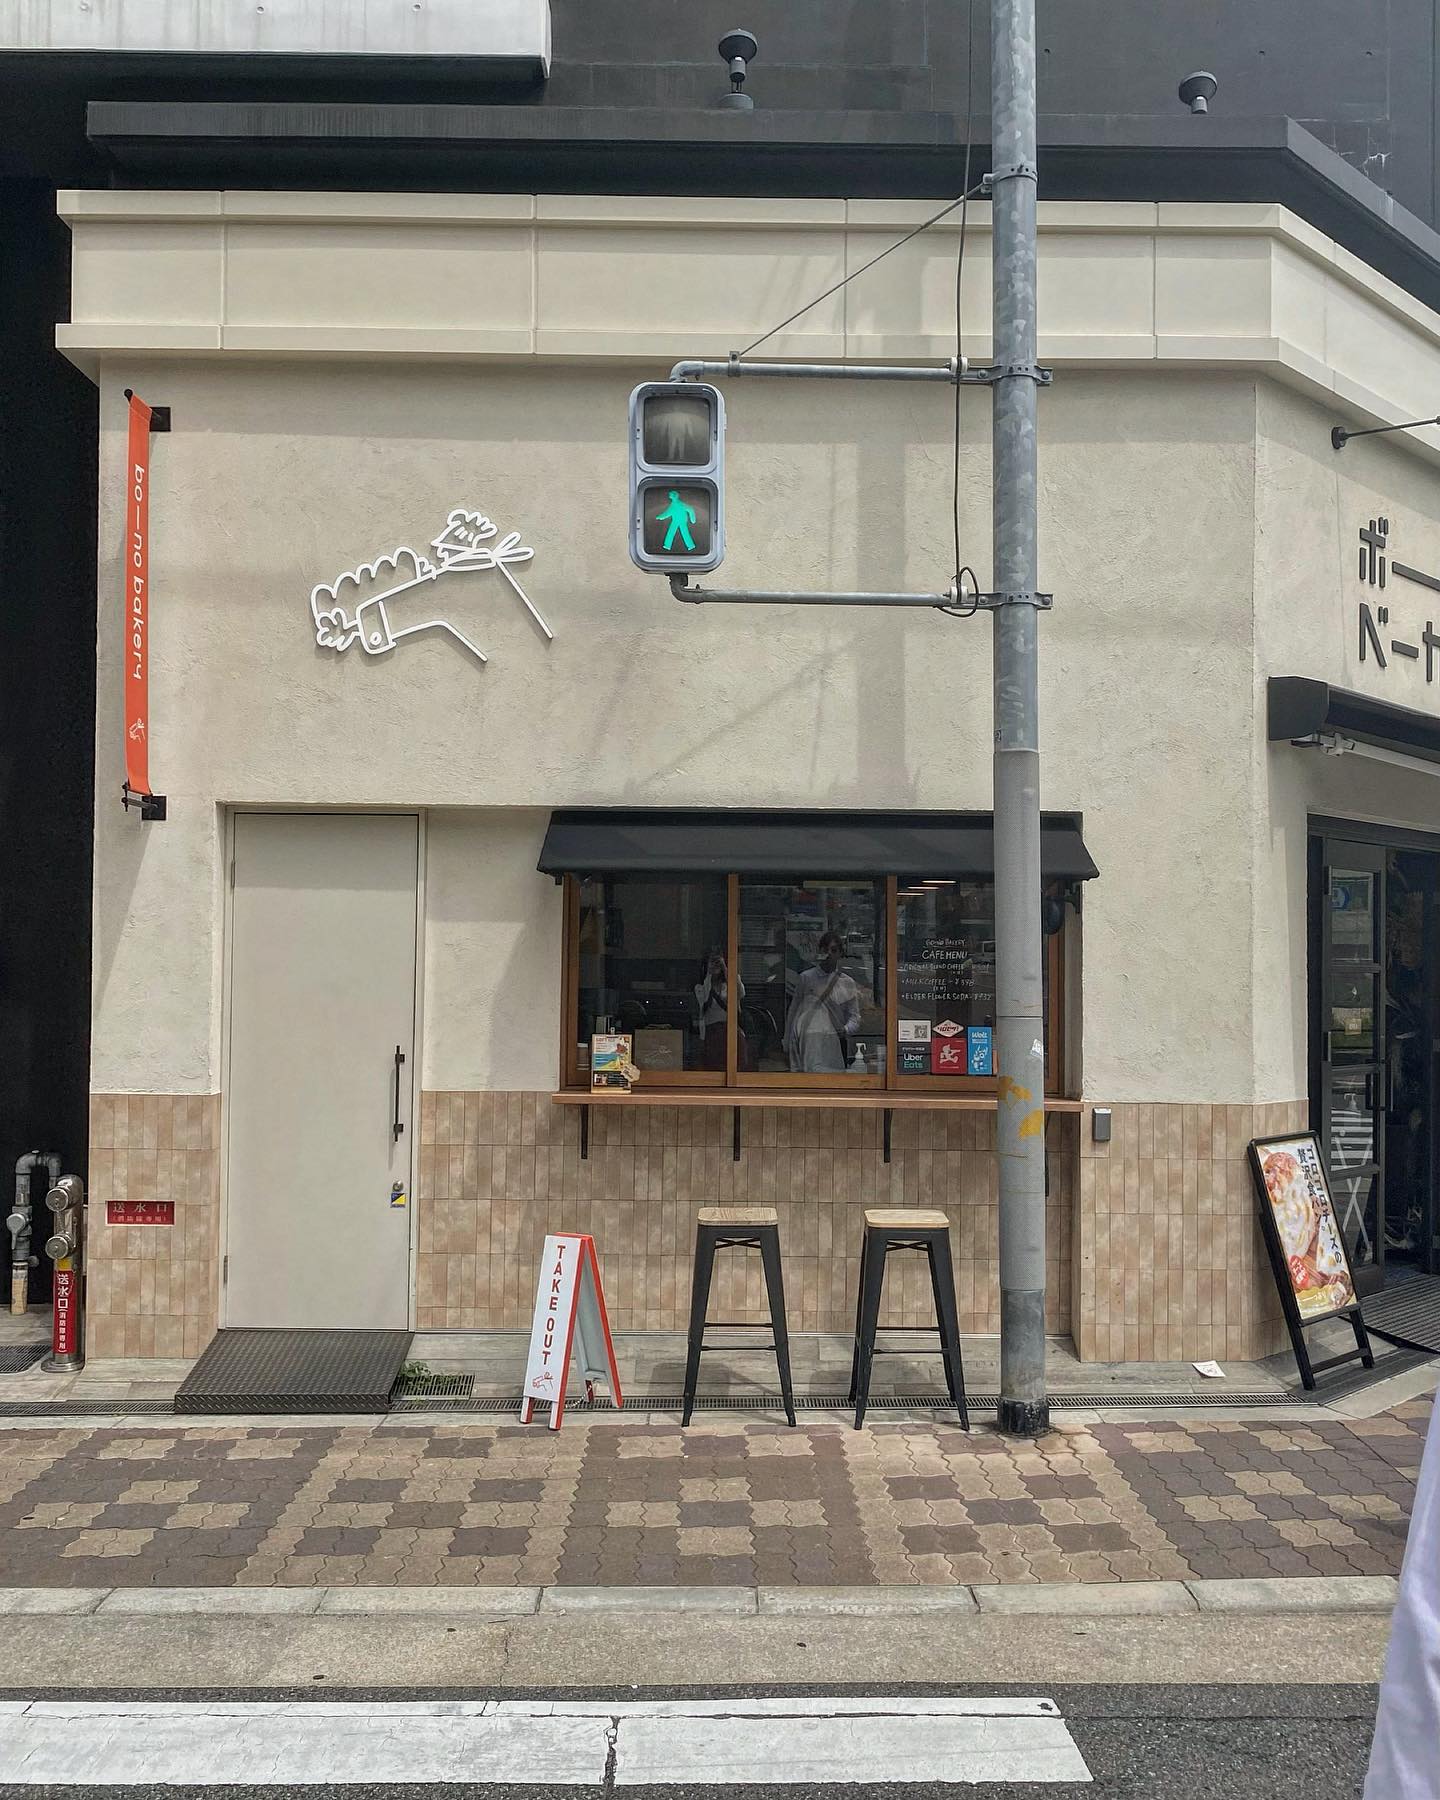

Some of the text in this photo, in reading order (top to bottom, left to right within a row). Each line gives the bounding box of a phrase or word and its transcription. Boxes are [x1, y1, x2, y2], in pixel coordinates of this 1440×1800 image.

[133, 575, 145, 680] bakery
[921, 949, 968, 960] CAFE MENU
[924, 978, 947, 986] COFFEE
[903, 1053, 923, 1061] Uber
[903, 1061, 923, 1069] Eats
[112, 1202, 167, 1213] 送水口
[542, 1244, 566, 1365] TAKE OUT
